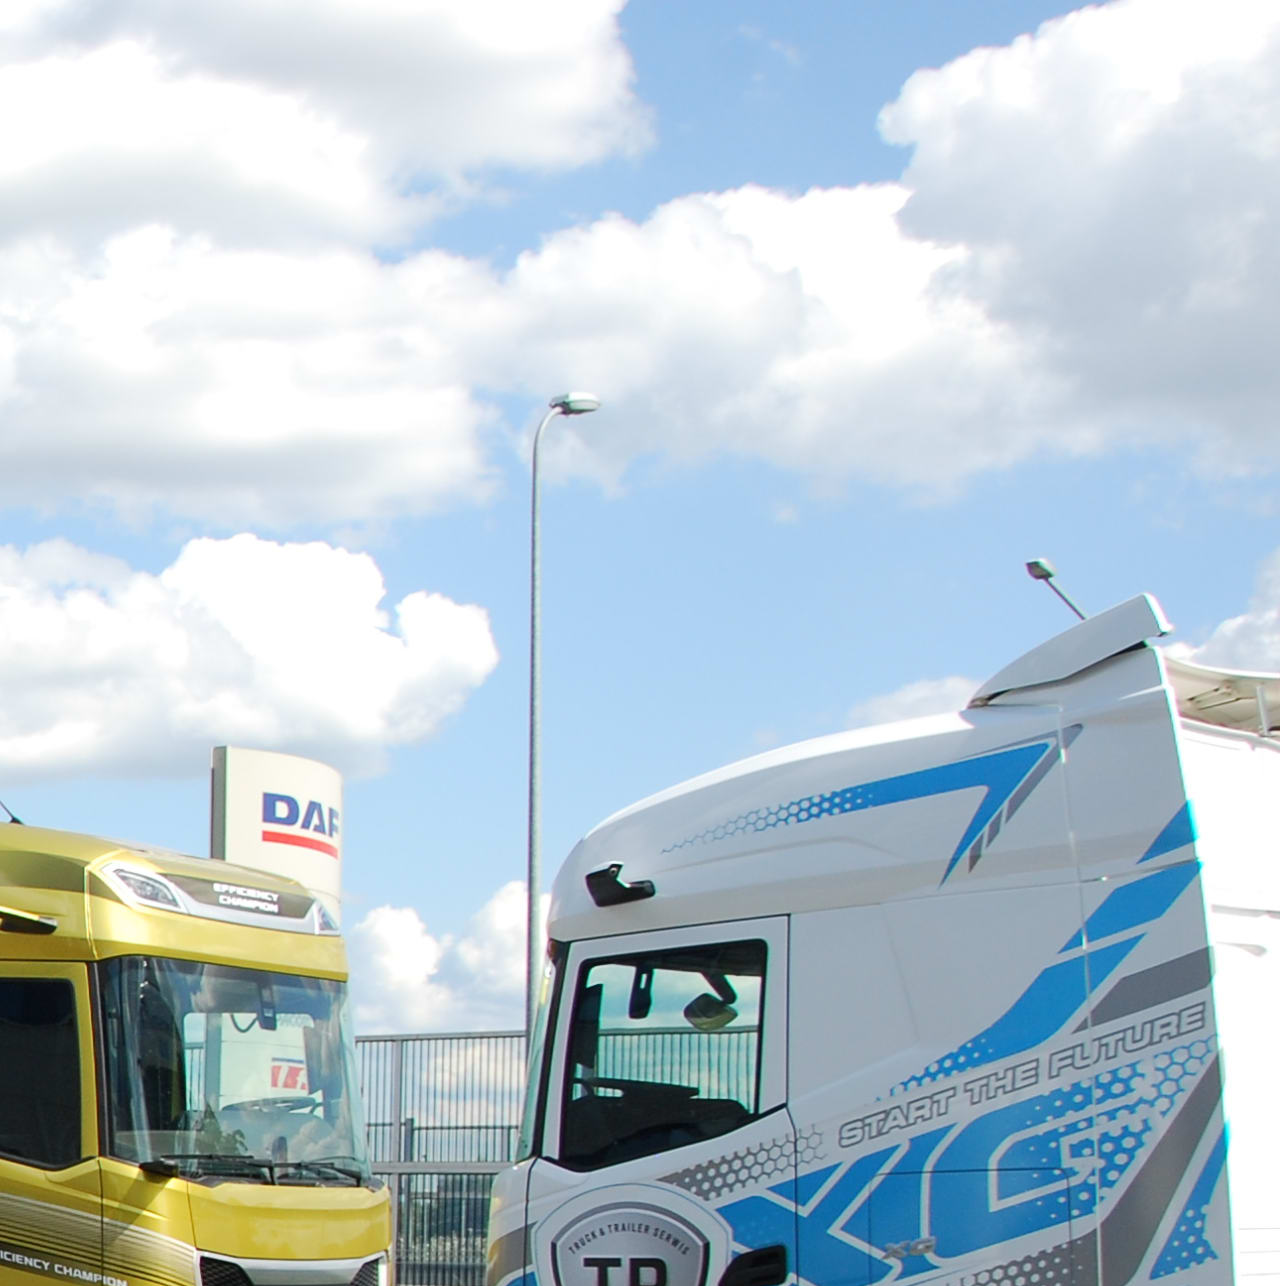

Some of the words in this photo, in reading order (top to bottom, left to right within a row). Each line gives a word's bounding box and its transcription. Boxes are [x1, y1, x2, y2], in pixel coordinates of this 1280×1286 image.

[261, 792, 339, 838] DAF
[839, 1086, 955, 1148] START
[963, 1057, 1040, 1106] THE
[1048, 1001, 1206, 1080] FUTURE
[568, 1231, 598, 1255] TRUCK
[608, 1223, 650, 1234] TRAILER
[653, 1227, 690, 1256] SERWIS
[882, 1236, 936, 1260] XG
